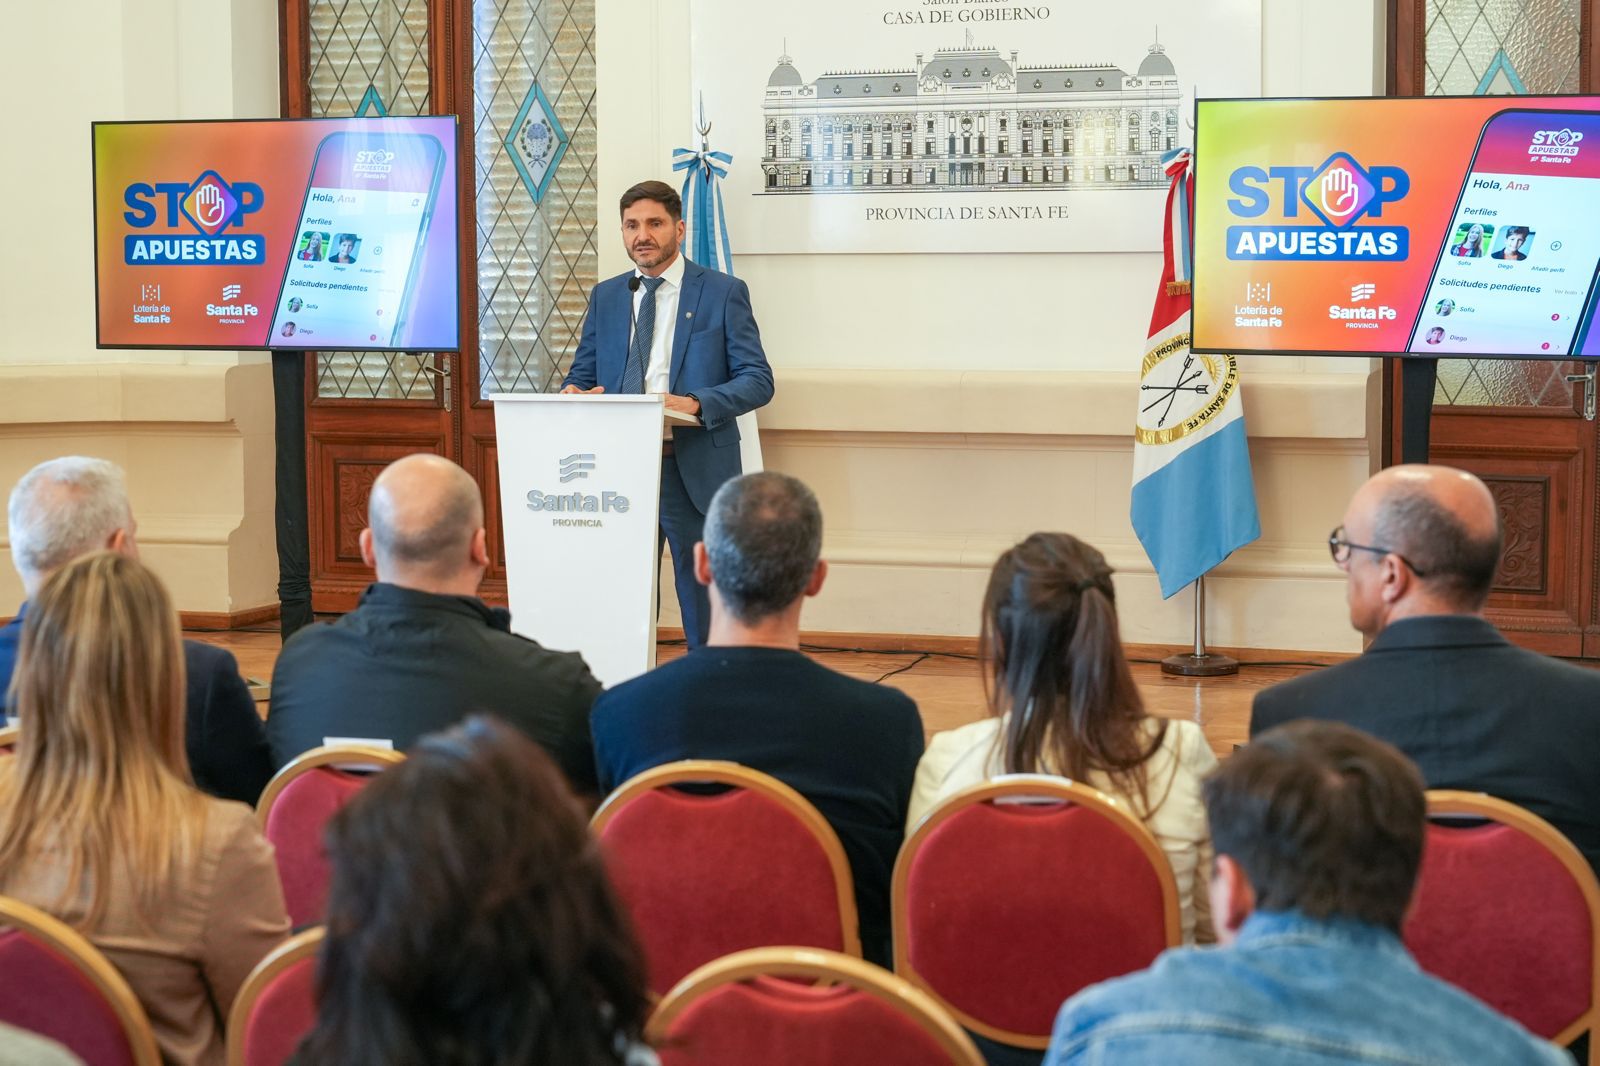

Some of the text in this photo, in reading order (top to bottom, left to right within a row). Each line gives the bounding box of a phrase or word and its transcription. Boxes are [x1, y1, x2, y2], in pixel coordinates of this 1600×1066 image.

[883, 6, 1050, 25] CASA DE GOBIERNO
[1532, 146, 1576, 155] APUESTAS
[1473, 179, 1530, 191] Hola, Ana
[312, 193, 335, 204] Hola,
[866, 205, 1069, 221] PROVINCIA DE SANTA FE
[1464, 207, 1498, 217] Perfiles
[306, 217, 332, 226] Perfiles
[132, 239, 257, 260] APUESTAS
[1235, 231, 1398, 256] APUESTAS
[290, 279, 328, 289] Solicitudes
[328, 282, 368, 292] pendientes
[1439, 278, 1542, 294] Solicitudes pendientes
[160, 304, 171, 313] de
[206, 303, 258, 316] Santa Fe
[1269, 305, 1283, 315] de
[1329, 305, 1397, 320] Santa Fe
[134, 314, 171, 324] Santa Fe
[1235, 317, 1283, 328] Santa Fe
[1450, 334, 1468, 342] Diego
[1155, 338, 1190, 358] PROVINC
[1221, 382, 1232, 395] DE
[1198, 395, 1224, 421] SANTA
[1187, 420, 1199, 430] FE
[526, 490, 630, 513] Santa Fe
[552, 519, 603, 528] PROVINCIA
